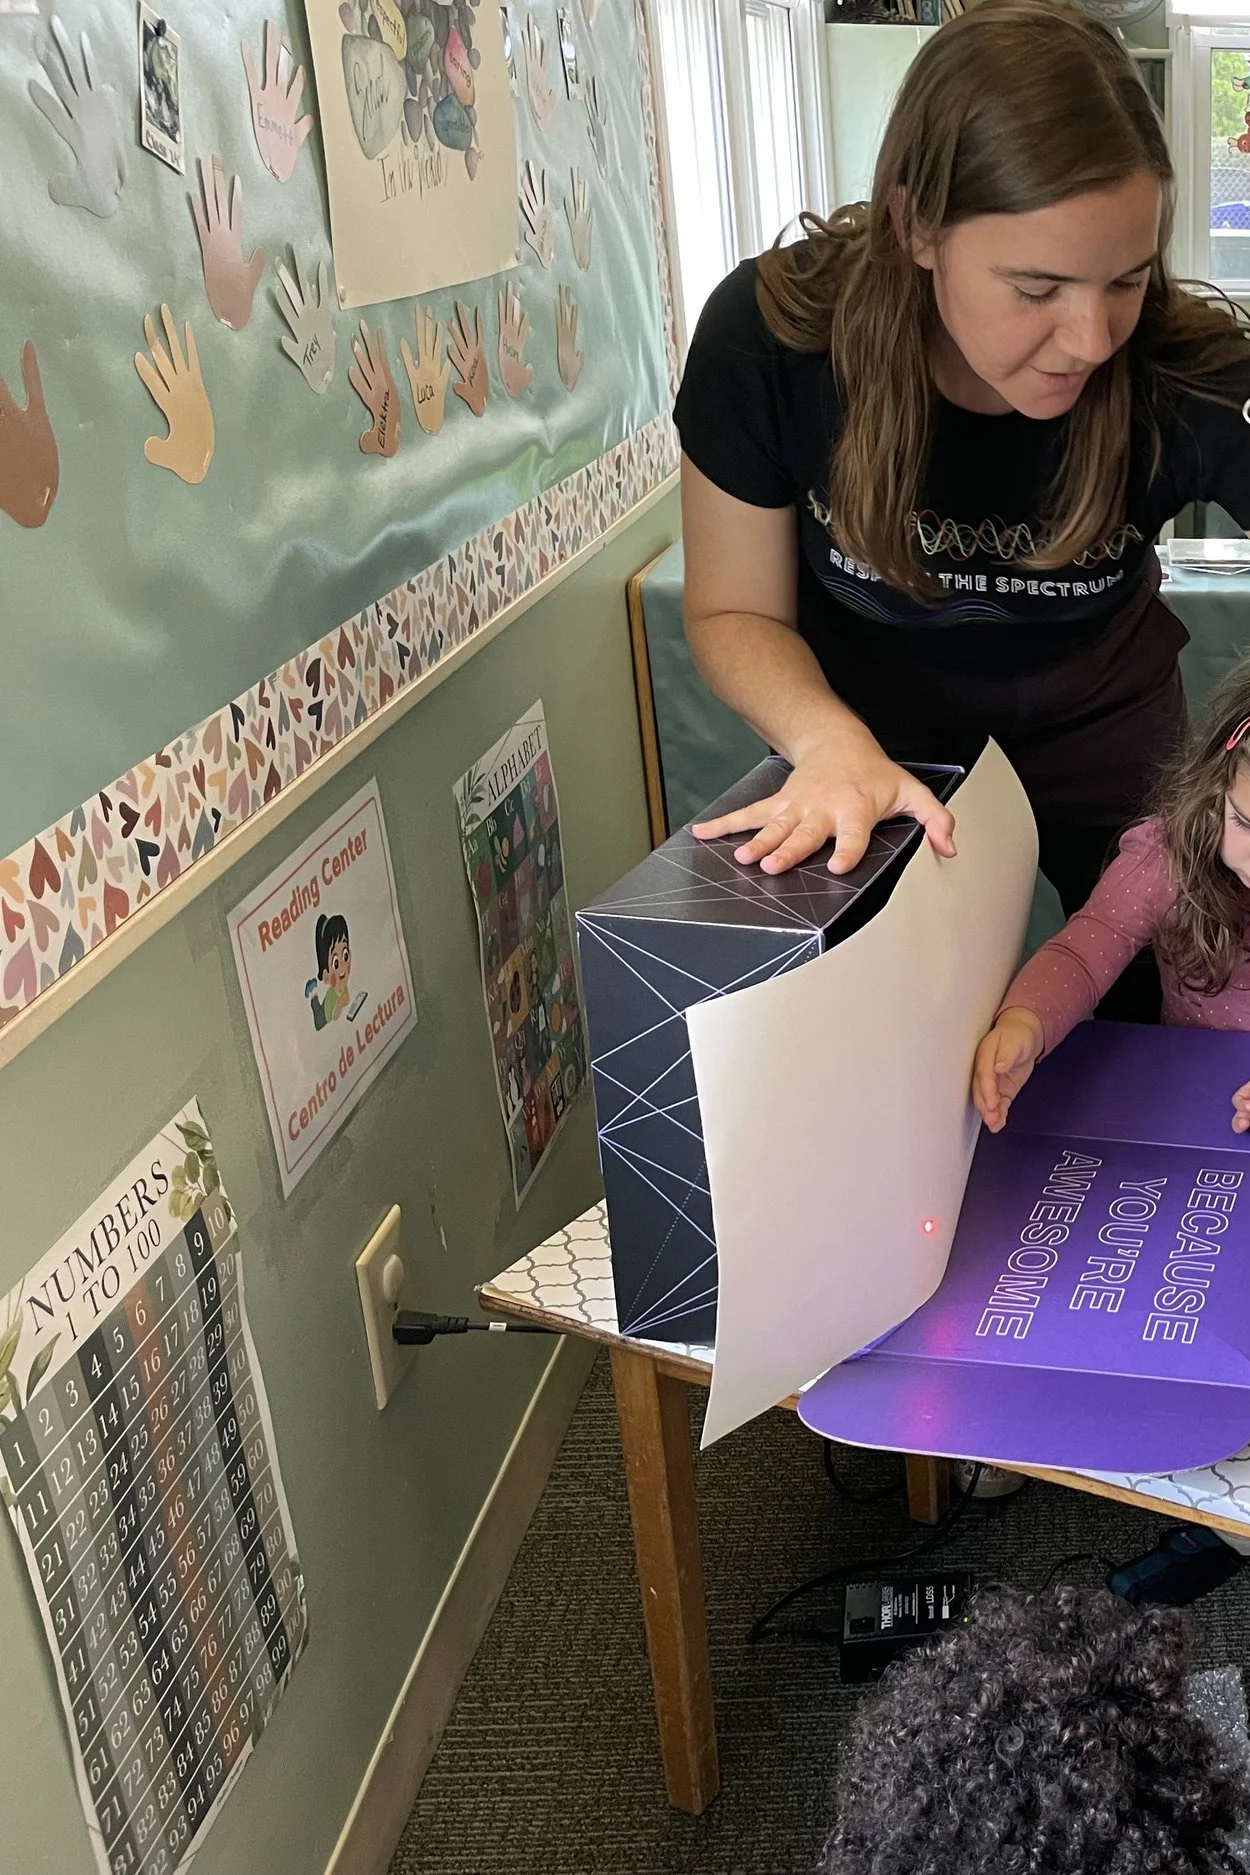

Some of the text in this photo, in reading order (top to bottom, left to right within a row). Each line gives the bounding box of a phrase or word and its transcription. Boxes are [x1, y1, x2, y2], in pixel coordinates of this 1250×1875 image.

[303, 333, 322, 367] Trey
[377, 388, 391, 450] Elektra
[938, 573, 988, 592] THE
[995, 569, 1124, 598] SPECTRUM
[488, 725, 542, 806] ALPHABET
[258, 828, 369, 952] Reading Center
[288, 991, 406, 1142] Centro de Lectura
[13, 1207, 224, 1468] 1 2 3 4 5 6 7 8 9 10
[26, 1159, 169, 1335] NUMBERS
[66, 1219, 161, 1342] 1 TO 100
[976, 1150, 1103, 1340] AWESOME
[1069, 1177, 1168, 1313] YOU'RE
[1143, 1168, 1244, 1344] BECAUSE
[26, 1253, 234, 1529] 11 12 13 14 15 16 17 18 19 20
[42, 1302, 238, 1583] 21 22 23 24 25 26 27 28 29 30
[55, 1348, 245, 1636] 31 32 33 34 35 36 37 38 39 40
[68, 1394, 254, 1684] 41 42 43 44 45 46 47 48 49 50
[78, 1438, 263, 1737] 51 52 53 54 55 56 57 58 59 60
[90, 1483, 273, 1784] 61 62 63 64 65 66 67 68 69 70
[102, 1526, 282, 1833] 71 72 73 74 75 76 77 78 79 80
[114, 1568, 292, 1875] 81 82 83 84 85 86 87 88 89 90
[169, 1815, 188, 1853] 93
[188, 1784, 206, 1821] 94
[206, 1752, 223, 1788] 95
[223, 1720, 240, 1756] 96
[240, 1689, 254, 1725] 97
[256, 1662, 272, 1696] 98
[272, 1635, 287, 1668] 99
